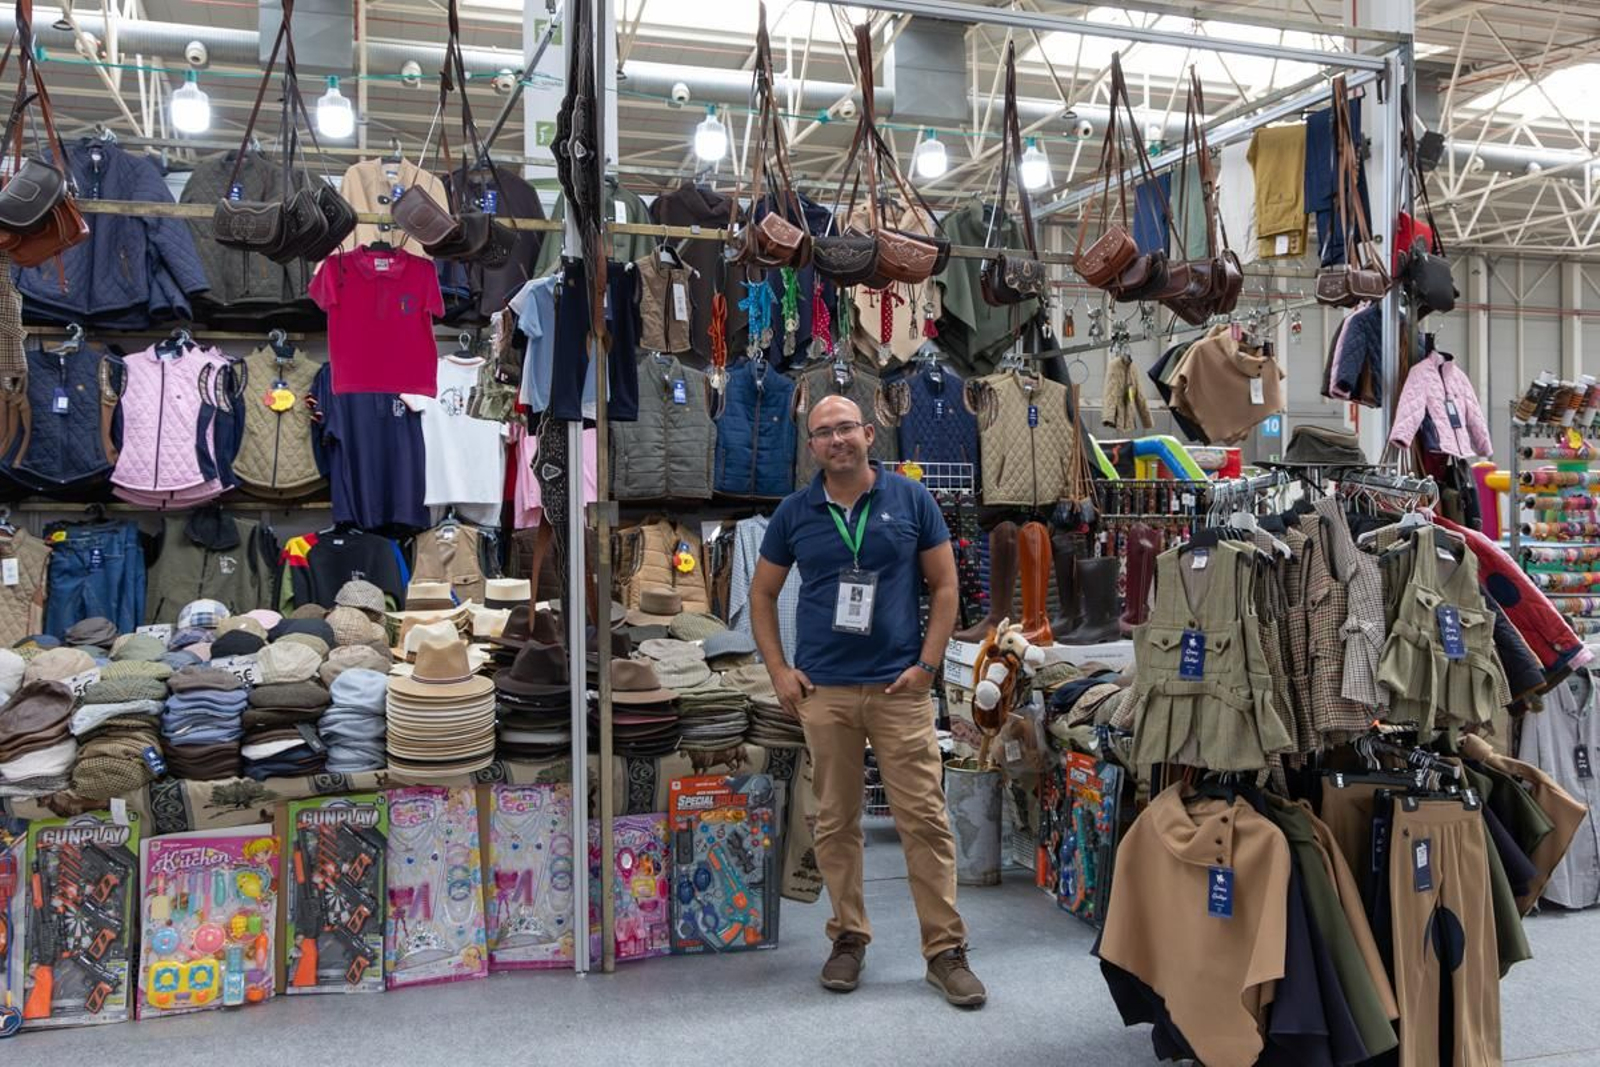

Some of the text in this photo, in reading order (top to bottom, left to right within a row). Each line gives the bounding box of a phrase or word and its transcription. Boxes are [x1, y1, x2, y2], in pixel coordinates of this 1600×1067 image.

[1263, 418, 1280, 433] 10
[677, 795, 714, 807] SPECIAL
[301, 807, 378, 827] GUNPLAY
[42, 825, 124, 845] GUNPLAY
[151, 846, 231, 873] Kitchen
